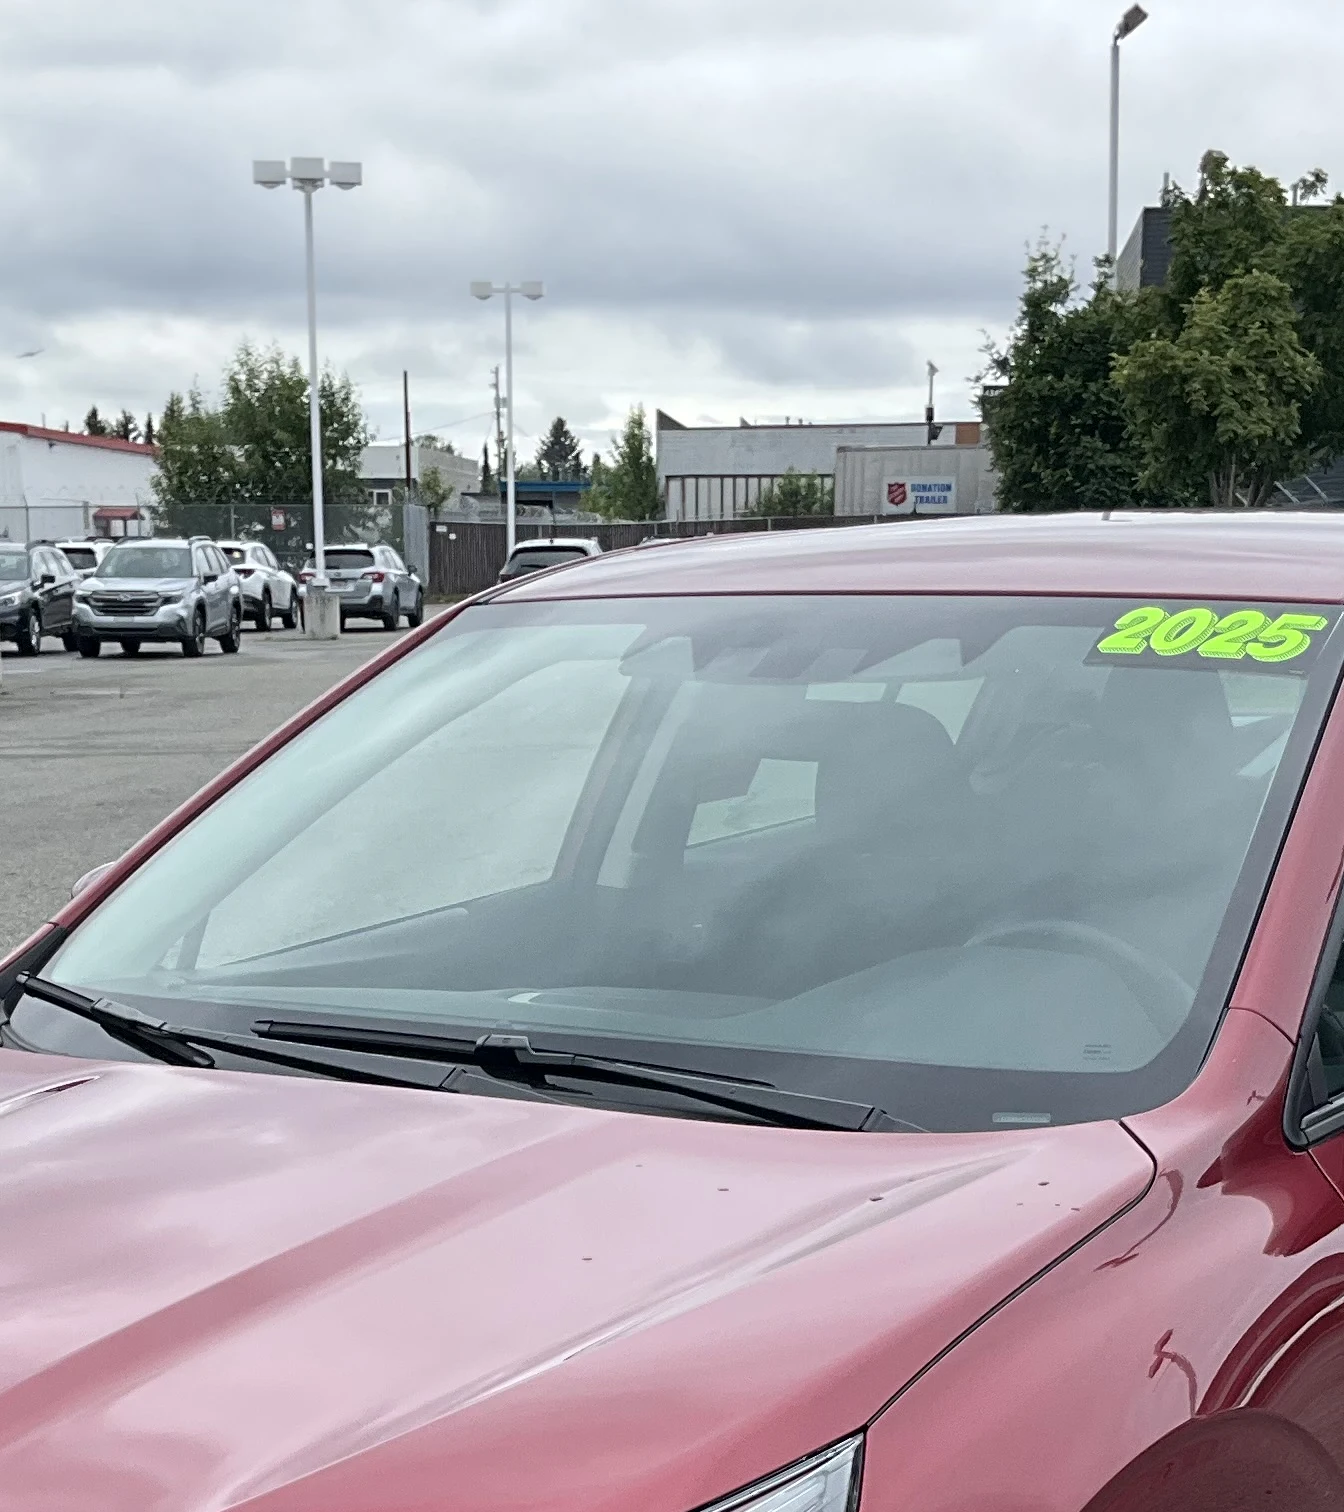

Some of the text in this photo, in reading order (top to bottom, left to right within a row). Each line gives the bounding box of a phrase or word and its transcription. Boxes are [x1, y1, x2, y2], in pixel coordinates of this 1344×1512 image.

[910, 483, 952, 492] DONATION
[914, 495, 948, 504] TRAILER
[1096, 606, 1329, 662] 2025
